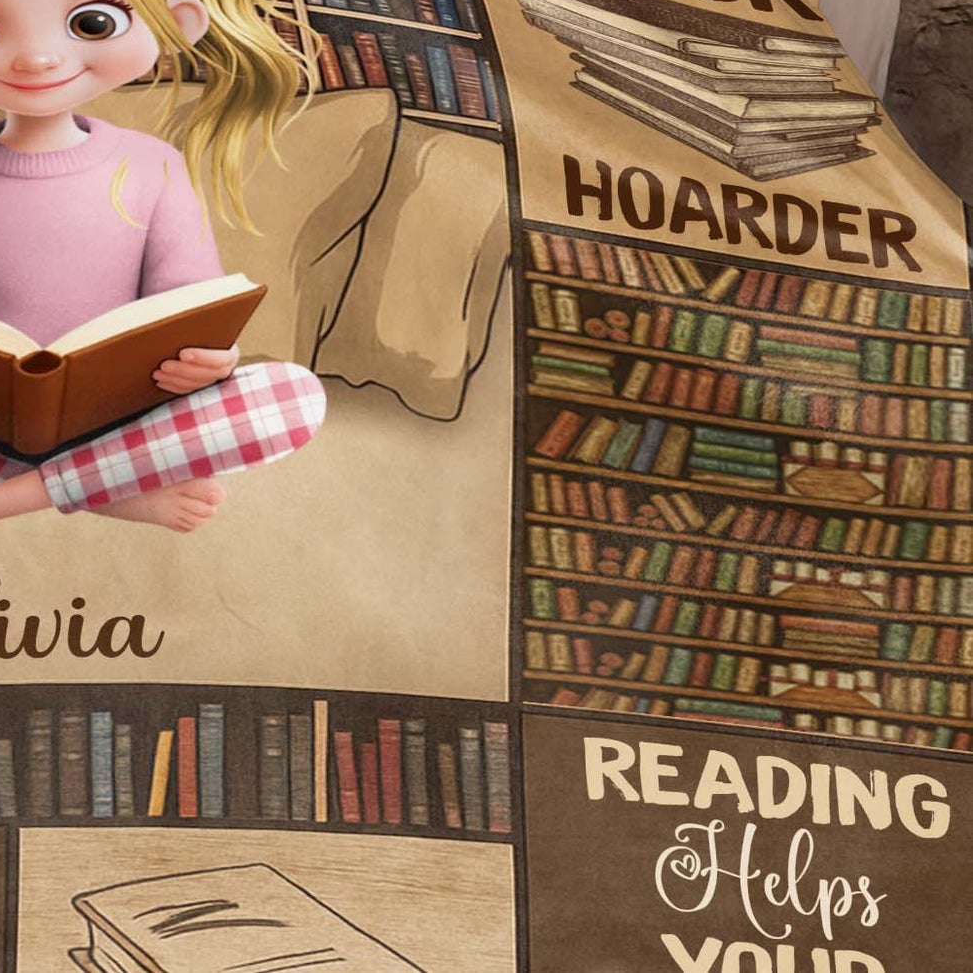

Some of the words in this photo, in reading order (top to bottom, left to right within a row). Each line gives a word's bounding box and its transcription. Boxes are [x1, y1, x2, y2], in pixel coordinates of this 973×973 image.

[563, 154, 923, 272] HOARDER
[583, 737, 951, 838] READING
[654, 819, 888, 941] Helps
